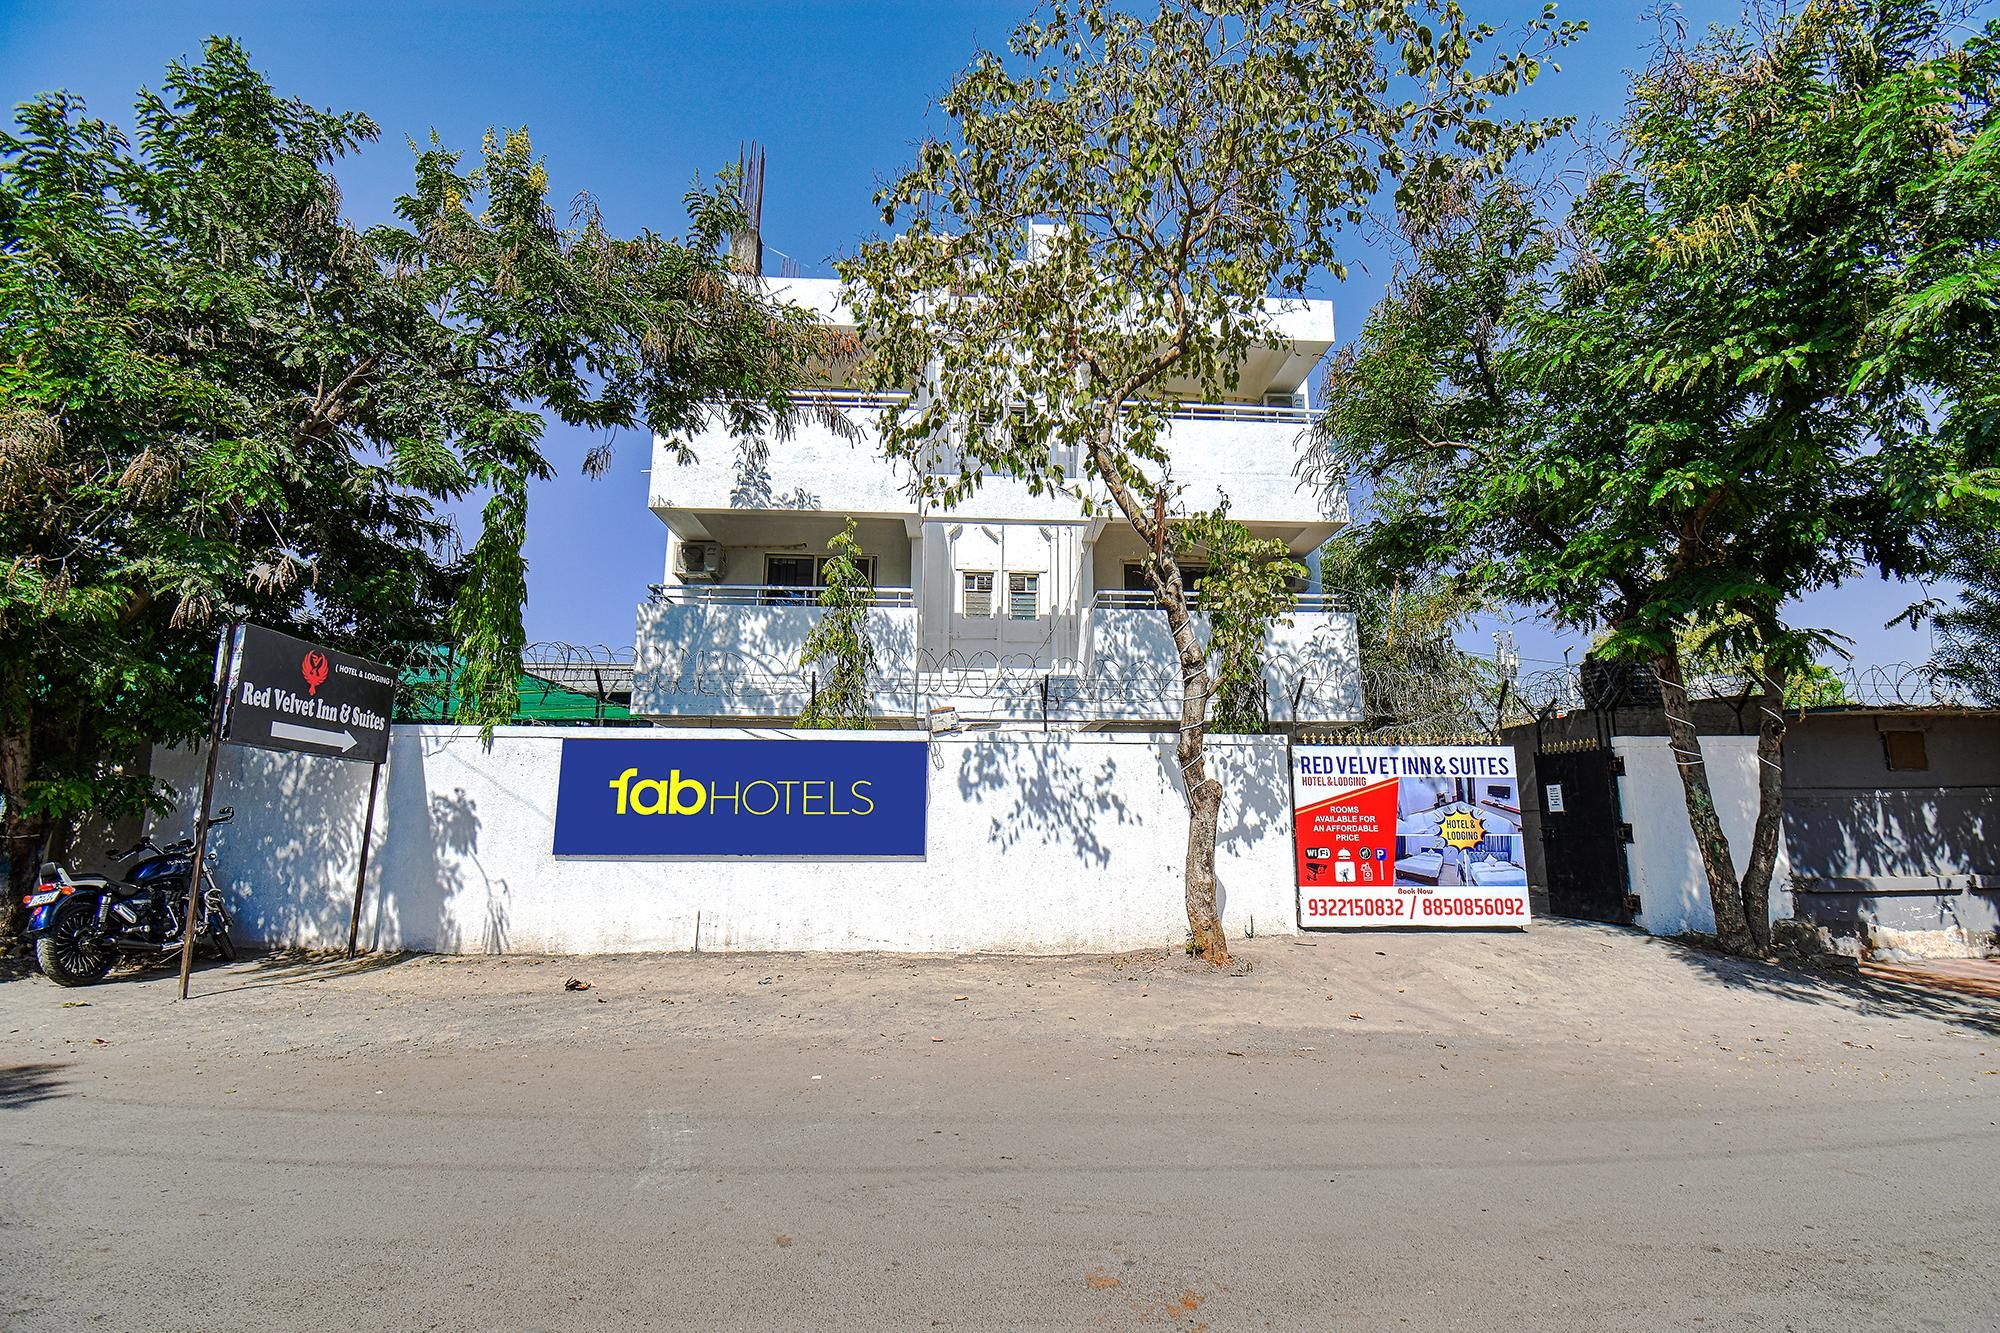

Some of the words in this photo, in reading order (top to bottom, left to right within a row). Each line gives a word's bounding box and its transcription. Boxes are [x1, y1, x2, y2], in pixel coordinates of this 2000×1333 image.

[358, 670, 364, 679] &
[241, 682, 272, 709] Red
[274, 688, 315, 718] Velvet
[316, 698, 338, 722] Inn
[339, 703, 352, 724] &
[351, 706, 386, 731] Suites
[1300, 756, 1333, 775] RED
[1336, 756, 1399, 775] VELVET
[1401, 756, 1432, 775] INN
[1434, 756, 1447, 775] &
[1449, 757, 1509, 775] SUITES
[1302, 776, 1326, 787] HOTEL
[1327, 776, 1334, 787] &
[1334, 776, 1367, 787] LODGING
[1330, 806, 1359, 814] ROOMS
[1315, 815, 1357, 823] AVAILABLE
[1359, 815, 1376, 823] FOR
[1446, 819, 1469, 829] HOTEL
[1470, 819, 1476, 829] &
[1326, 825, 1379, 833] AFFORDABLE
[1335, 834, 1360, 842] PRICE
[1447, 831, 1479, 841] LODGING
[1308, 898, 1404, 917] 9322150832
[1409, 895, 1417, 919] /
[1422, 898, 1525, 917] 8850856092
